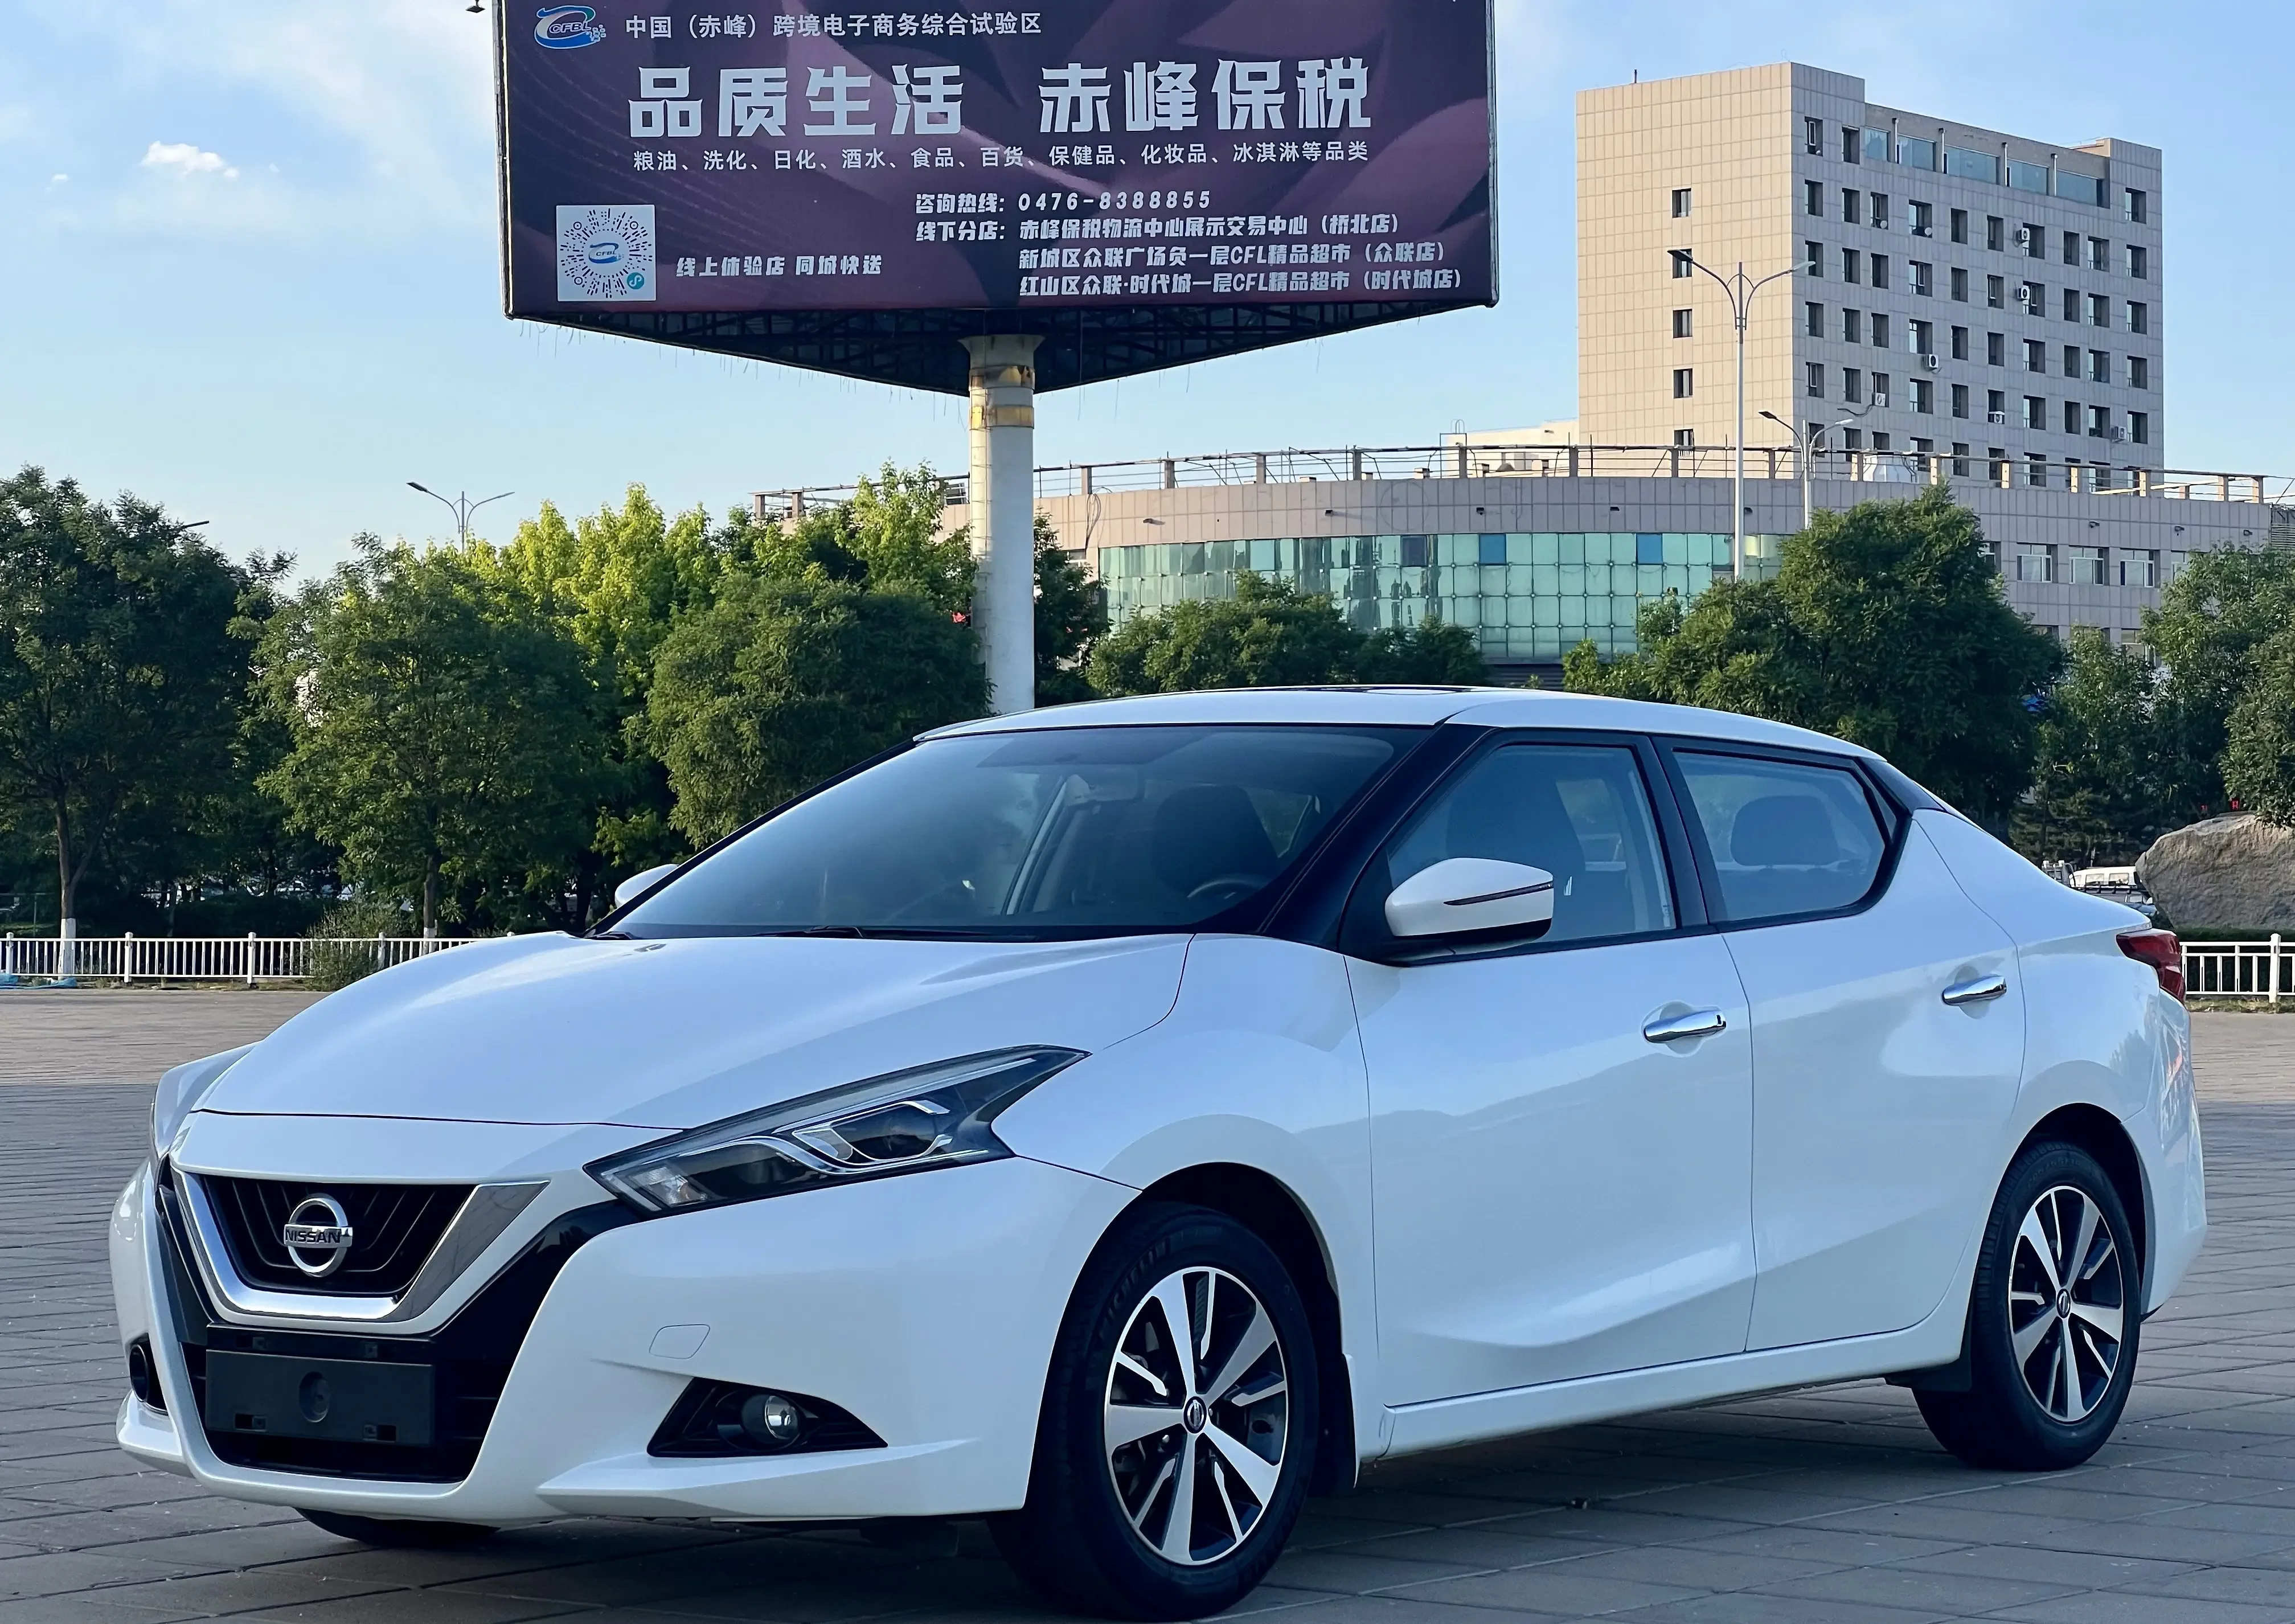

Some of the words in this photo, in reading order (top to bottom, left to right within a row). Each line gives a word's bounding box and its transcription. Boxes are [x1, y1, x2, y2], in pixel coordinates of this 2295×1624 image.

[548, 22, 592, 34] CFBL
[626, 11, 1041, 39] 中国（赤峰）跨境电子商务综合试验区
[628, 63, 964, 137] 品质生活
[1038, 56, 1371, 133] 赤峰保税
[633, 141, 1368, 171] 粮油、洗化、日化、酒水、食品、百货、保健品、化妆品、冰淇淋等品类
[916, 192, 1005, 214] 咨询热线：
[1018, 190, 1210, 211] 0476-8388855
[916, 220, 1005, 241] 线下分店：
[676, 256, 785, 277] 线上体验店
[796, 255, 882, 275] 同城快送
[285, 1229, 341, 1244] NISSAN
